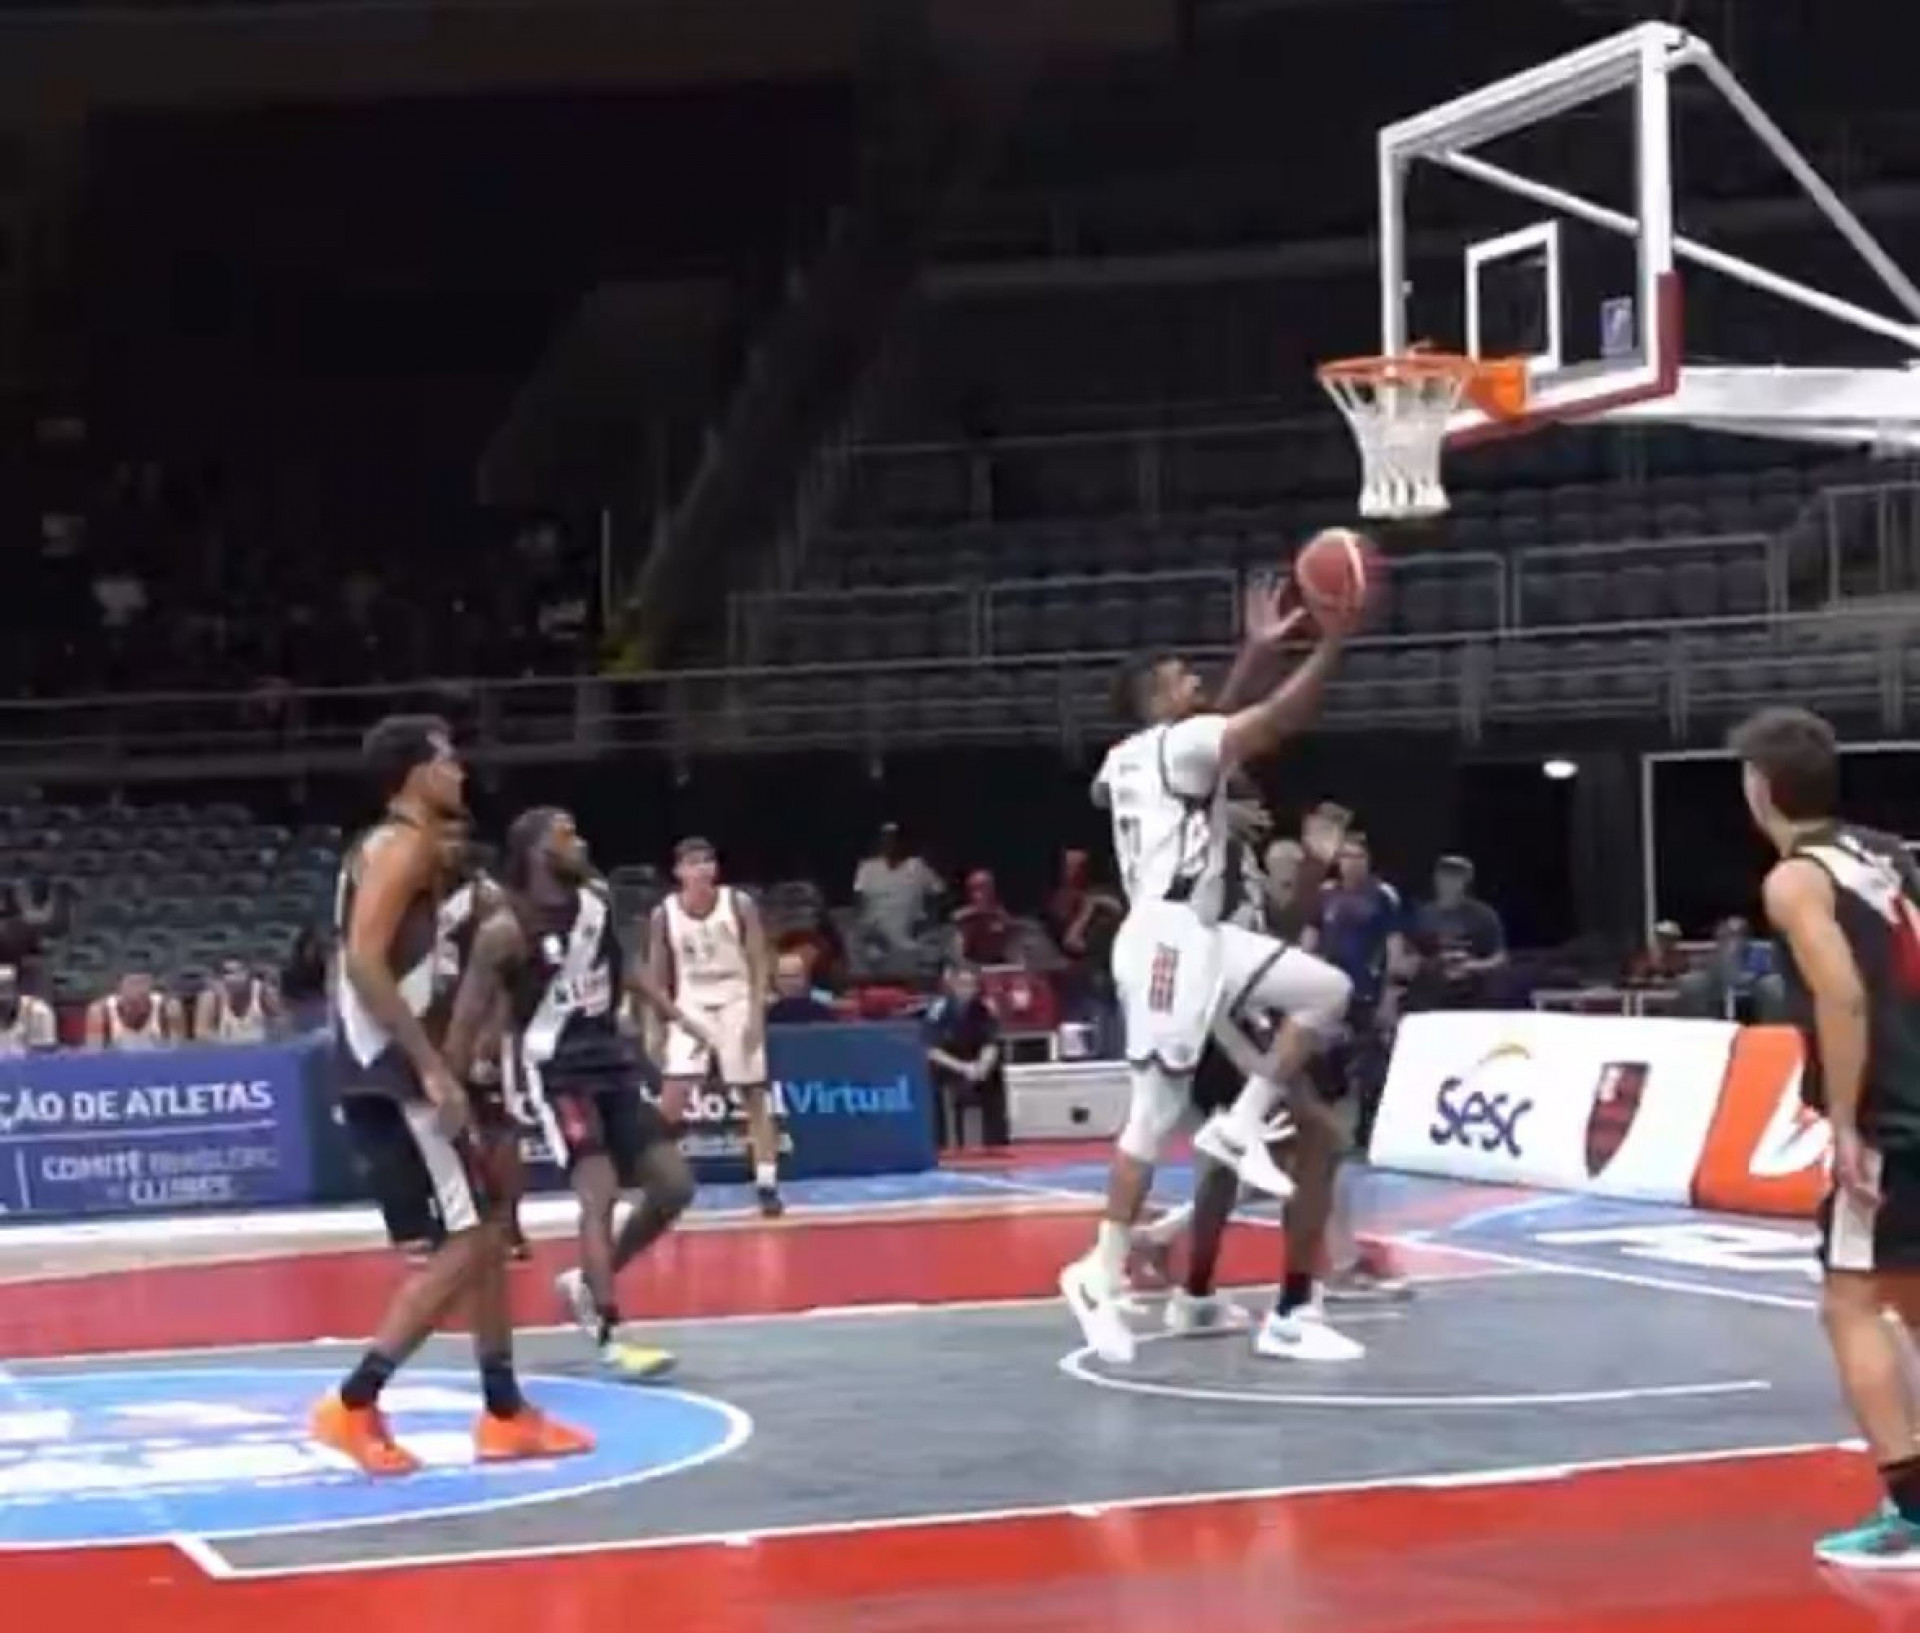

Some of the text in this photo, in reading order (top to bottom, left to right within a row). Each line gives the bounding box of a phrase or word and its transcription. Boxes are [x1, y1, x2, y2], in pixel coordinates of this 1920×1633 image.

[71, 1089, 118, 1121] DE
[126, 1081, 274, 1118] ATLETAS
[788, 1075, 914, 1117] Virtual
